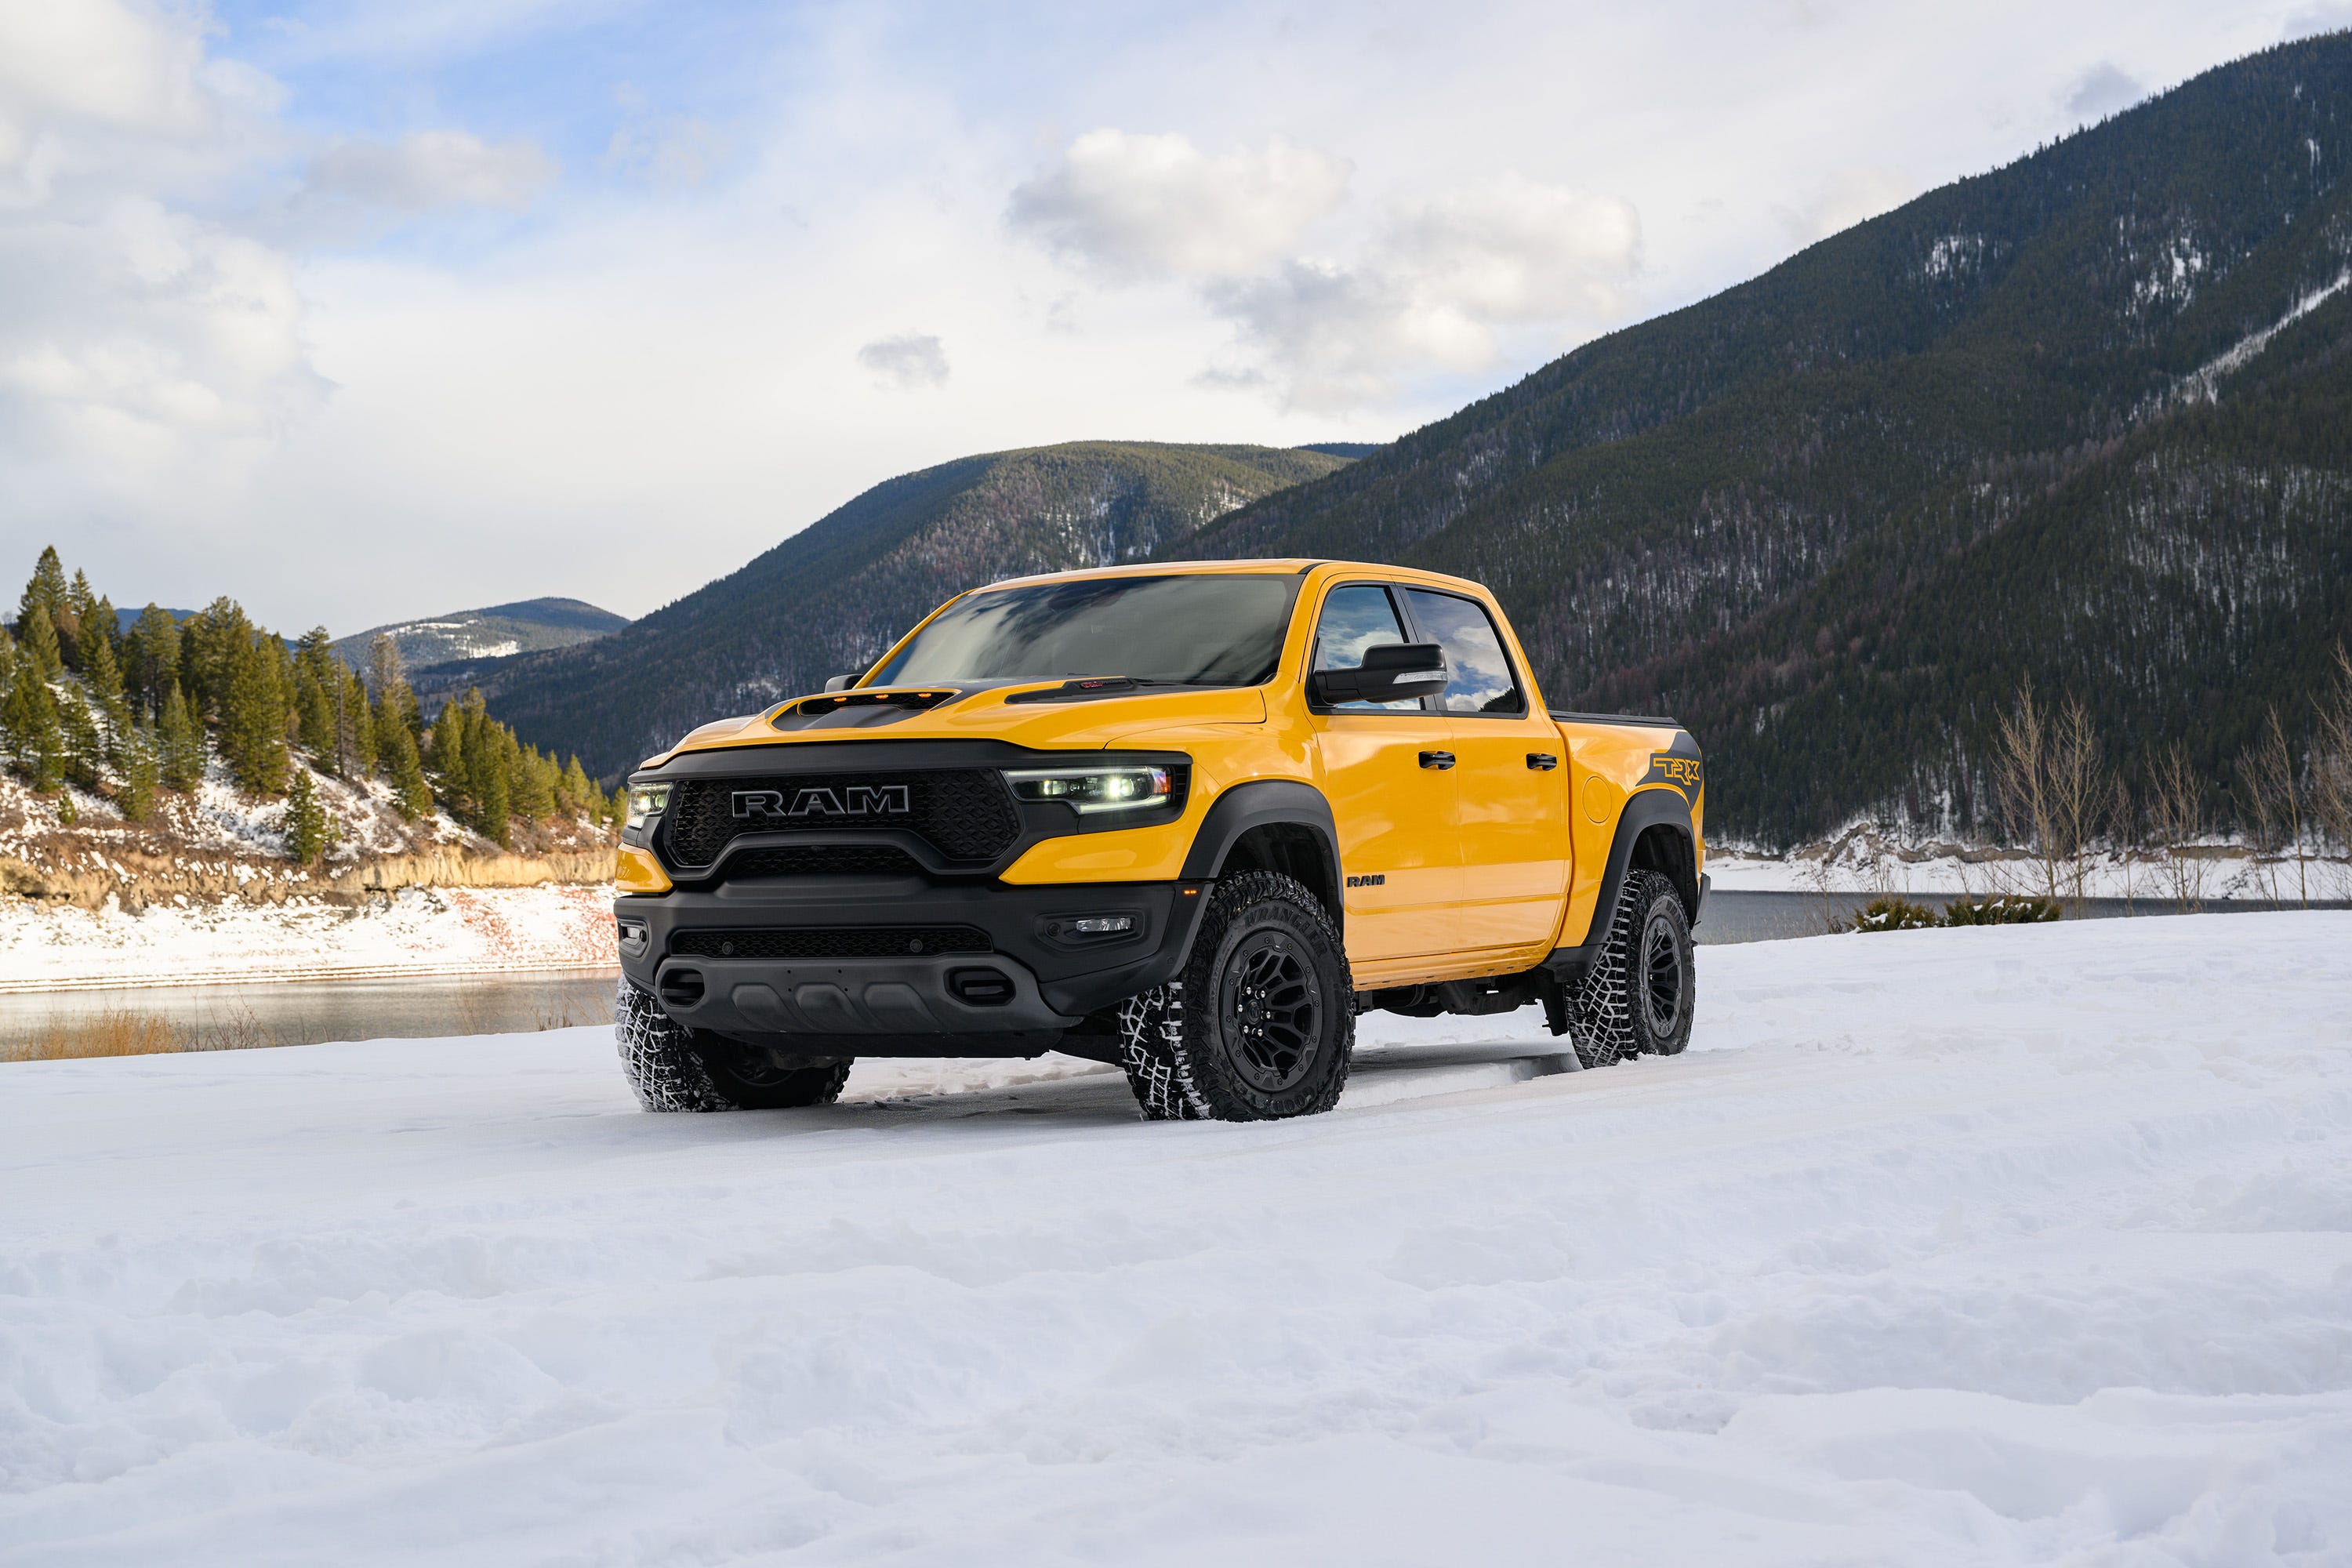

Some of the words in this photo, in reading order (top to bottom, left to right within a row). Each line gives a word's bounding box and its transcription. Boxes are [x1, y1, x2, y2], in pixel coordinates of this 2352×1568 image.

[1653, 757, 1700, 786] TRX
[731, 785, 909, 818] RAM
[1347, 874, 1385, 887] RAM
[1245, 906, 1327, 958] WRANGLER
